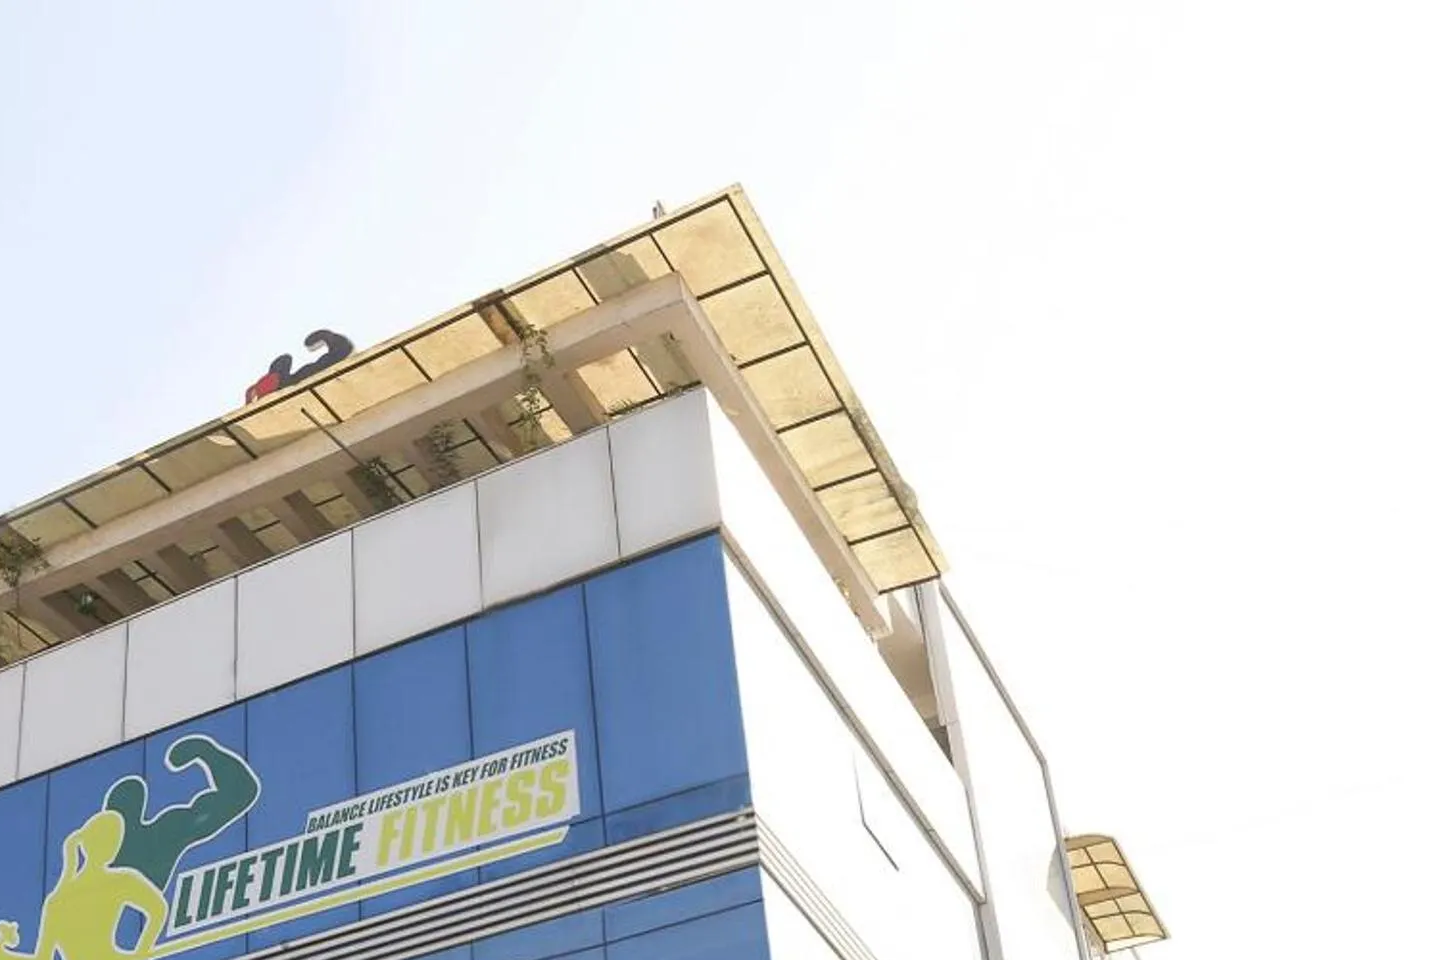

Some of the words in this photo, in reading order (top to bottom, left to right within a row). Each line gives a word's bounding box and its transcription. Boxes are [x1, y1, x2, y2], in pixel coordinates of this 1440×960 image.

[173, 823, 363, 929] LIFETIME
[375, 758, 571, 868] FITNESS
[307, 803, 367, 834] BALANCE
[367, 780, 434, 815] LIFESTYLE
[435, 774, 450, 795] IS
[452, 765, 480, 789] KEY
[480, 757, 508, 780] FOR
[510, 738, 569, 771] FITNESS
